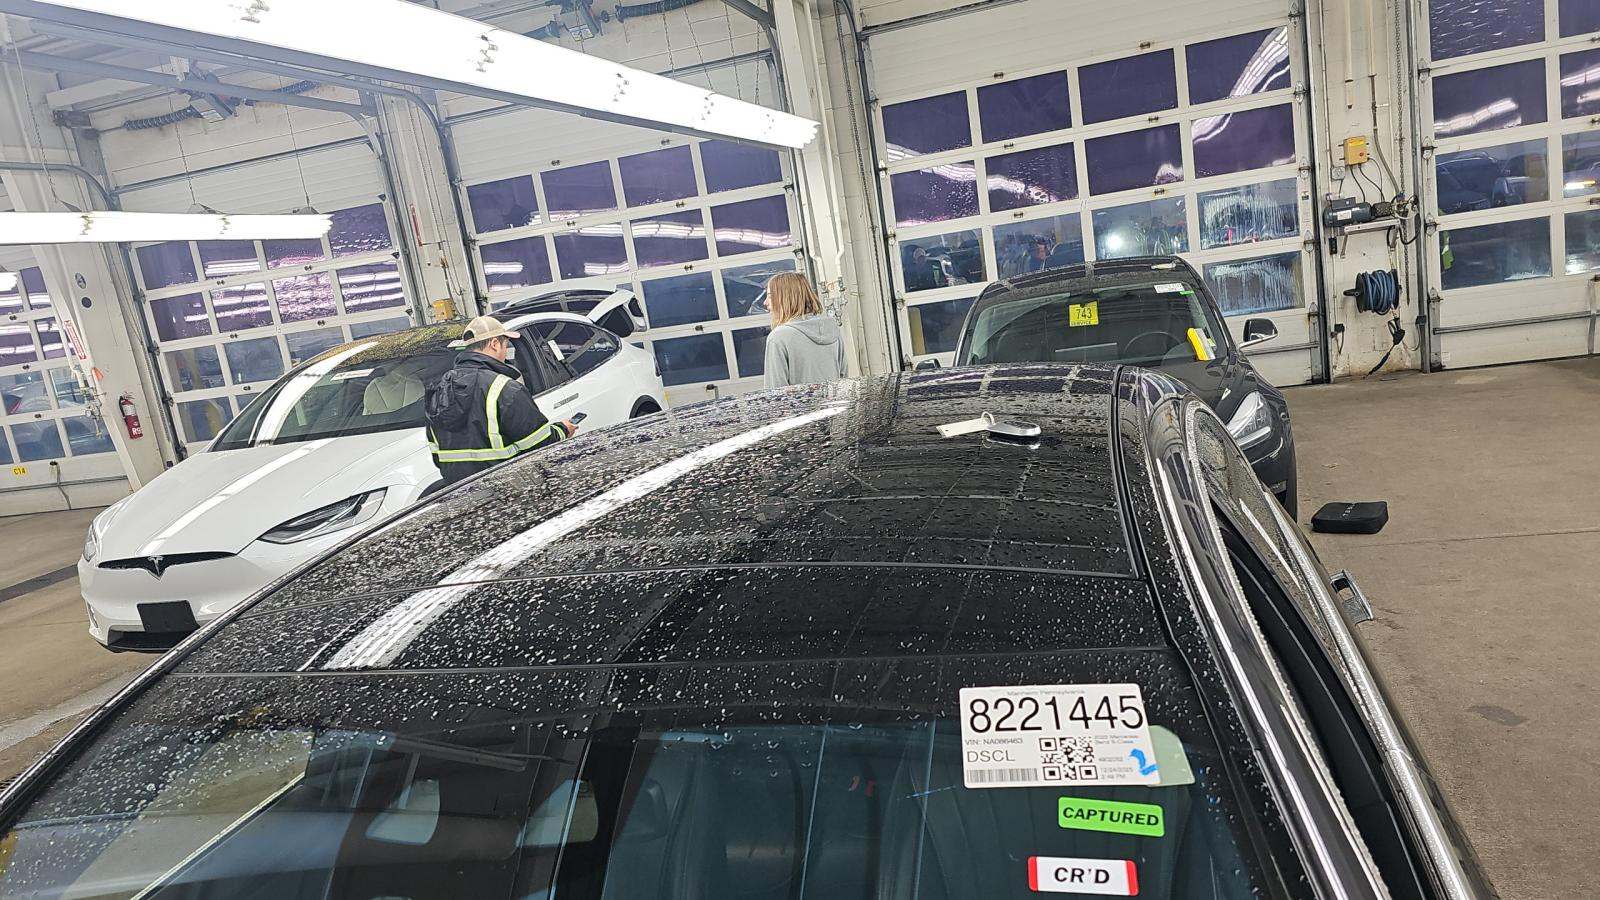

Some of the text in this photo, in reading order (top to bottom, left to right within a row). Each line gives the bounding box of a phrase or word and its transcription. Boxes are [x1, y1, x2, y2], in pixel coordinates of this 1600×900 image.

[1076, 308, 1092, 319] 743
[969, 695, 1143, 733] 8221445
[967, 749, 1016, 763] DSCL
[1063, 807, 1159, 826] CAPTURED
[1054, 867, 1110, 884] CR'D
